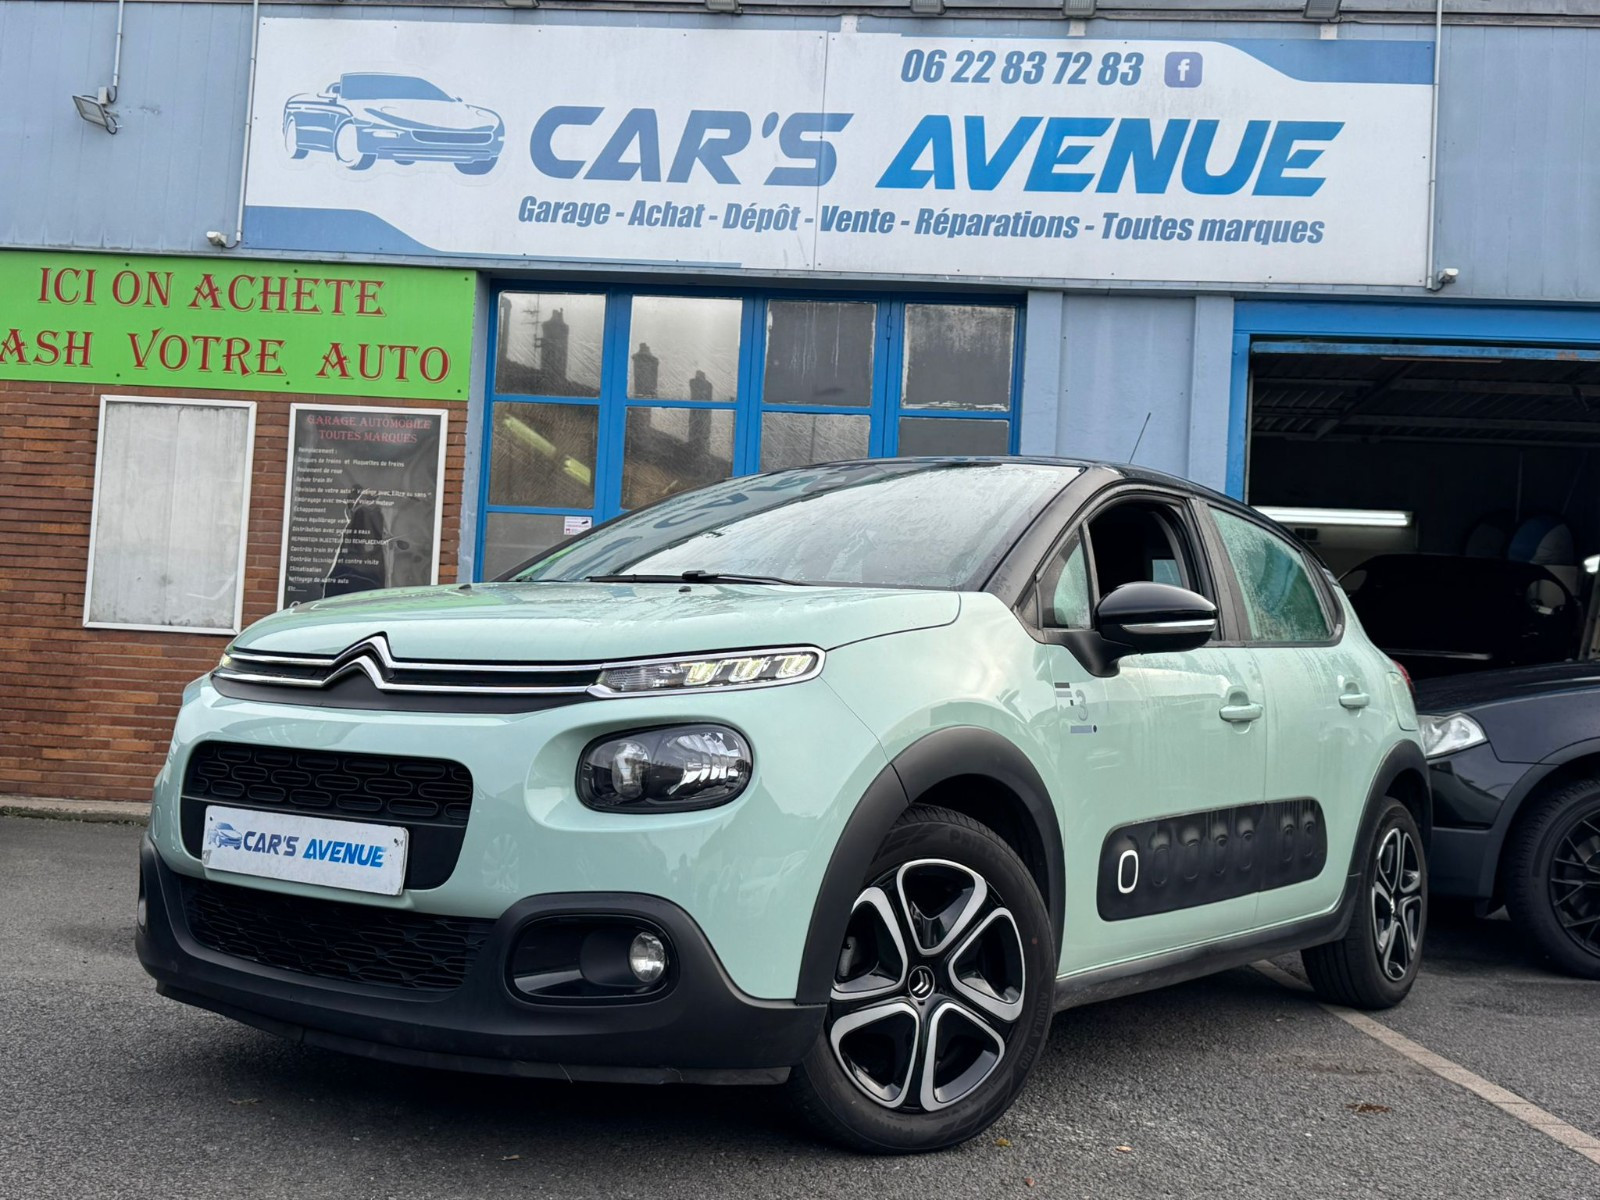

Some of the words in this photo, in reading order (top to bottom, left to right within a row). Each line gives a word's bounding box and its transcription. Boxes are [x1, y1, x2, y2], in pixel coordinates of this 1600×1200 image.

[900, 49, 947, 83] 06
[950, 50, 996, 83] 22
[1001, 50, 1047, 84] 83
[1052, 52, 1092, 84] 72
[1097, 52, 1144, 86] 83
[529, 105, 853, 187] CAR'S
[875, 114, 1345, 197] AVENUE
[518, 196, 610, 228] Garage
[628, 200, 705, 228] Achat
[722, 202, 800, 232] Dépôt
[819, 205, 896, 234] Vente
[915, 208, 1080, 239] Réparations
[1101, 212, 1194, 242] Toutes
[1198, 218, 1325, 246] marques
[38, 267, 97, 305] ICI
[112, 270, 174, 307] ON
[188, 273, 386, 317] ACHETE
[127, 327, 287, 377] VOTRE
[316, 342, 451, 383] AUTO
[306, 414, 356, 427] GARAGE
[359, 417, 432, 430] AUTOMOBILE
[319, 429, 361, 441] TOUTES
[363, 431, 418, 443] MARQUES
[243, 831, 299, 857] CAR'S
[302, 838, 387, 868] AVENUE
